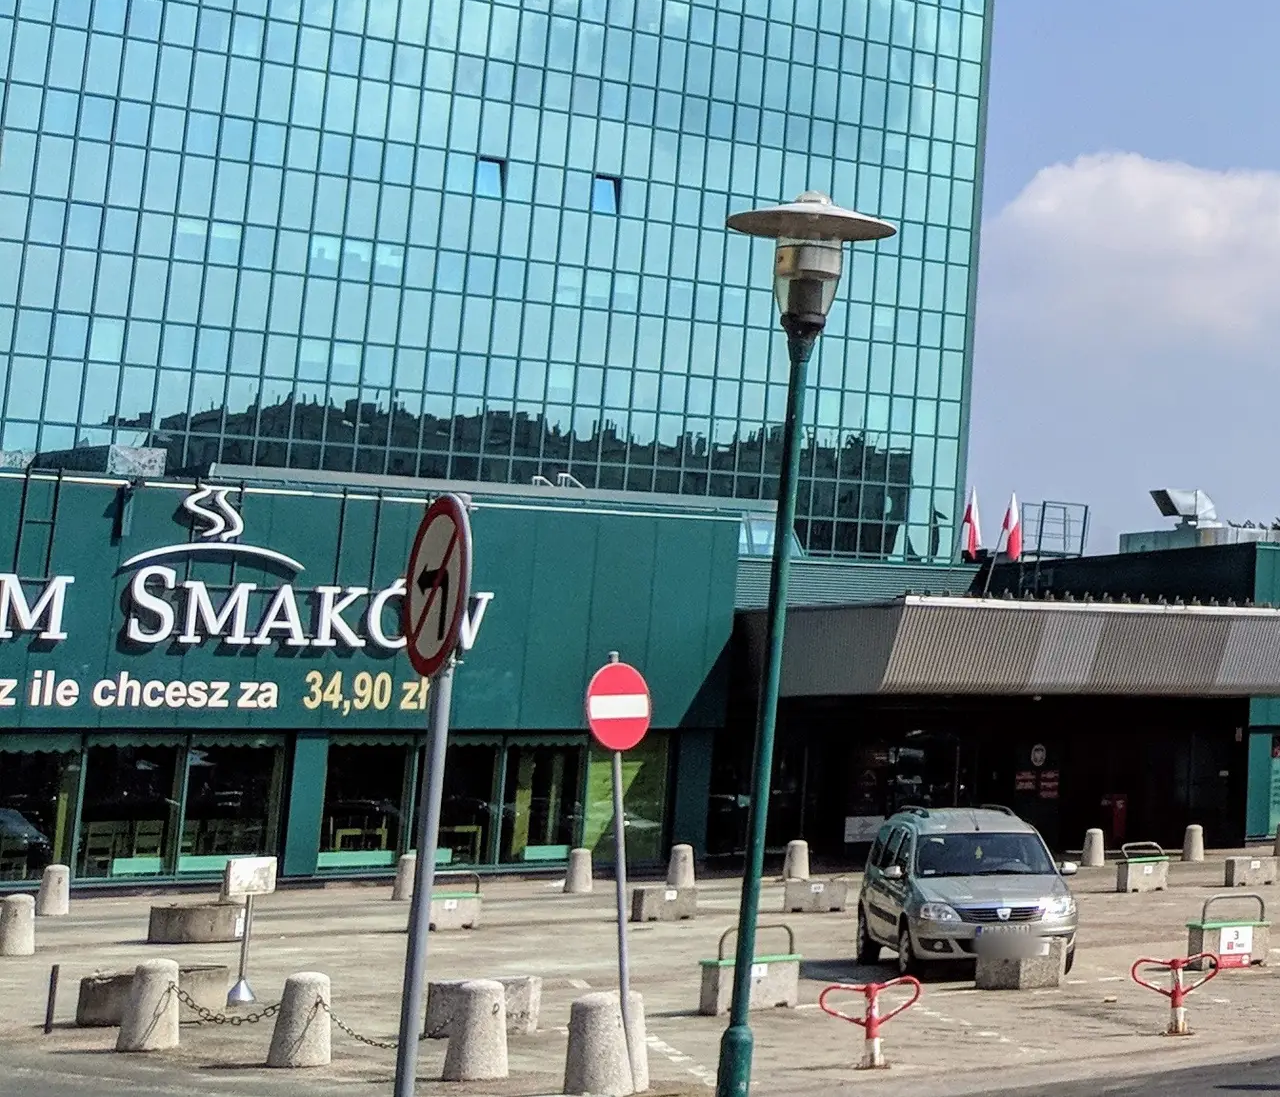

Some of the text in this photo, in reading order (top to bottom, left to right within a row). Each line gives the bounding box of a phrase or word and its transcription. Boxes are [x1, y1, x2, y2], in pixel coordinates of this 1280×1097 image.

[30, 669, 79, 707] ile
[92, 675, 229, 708] chcesz
[236, 681, 278, 709] za
[303, 670, 392, 716] 34,90
[1233, 930, 1239, 940] 3
